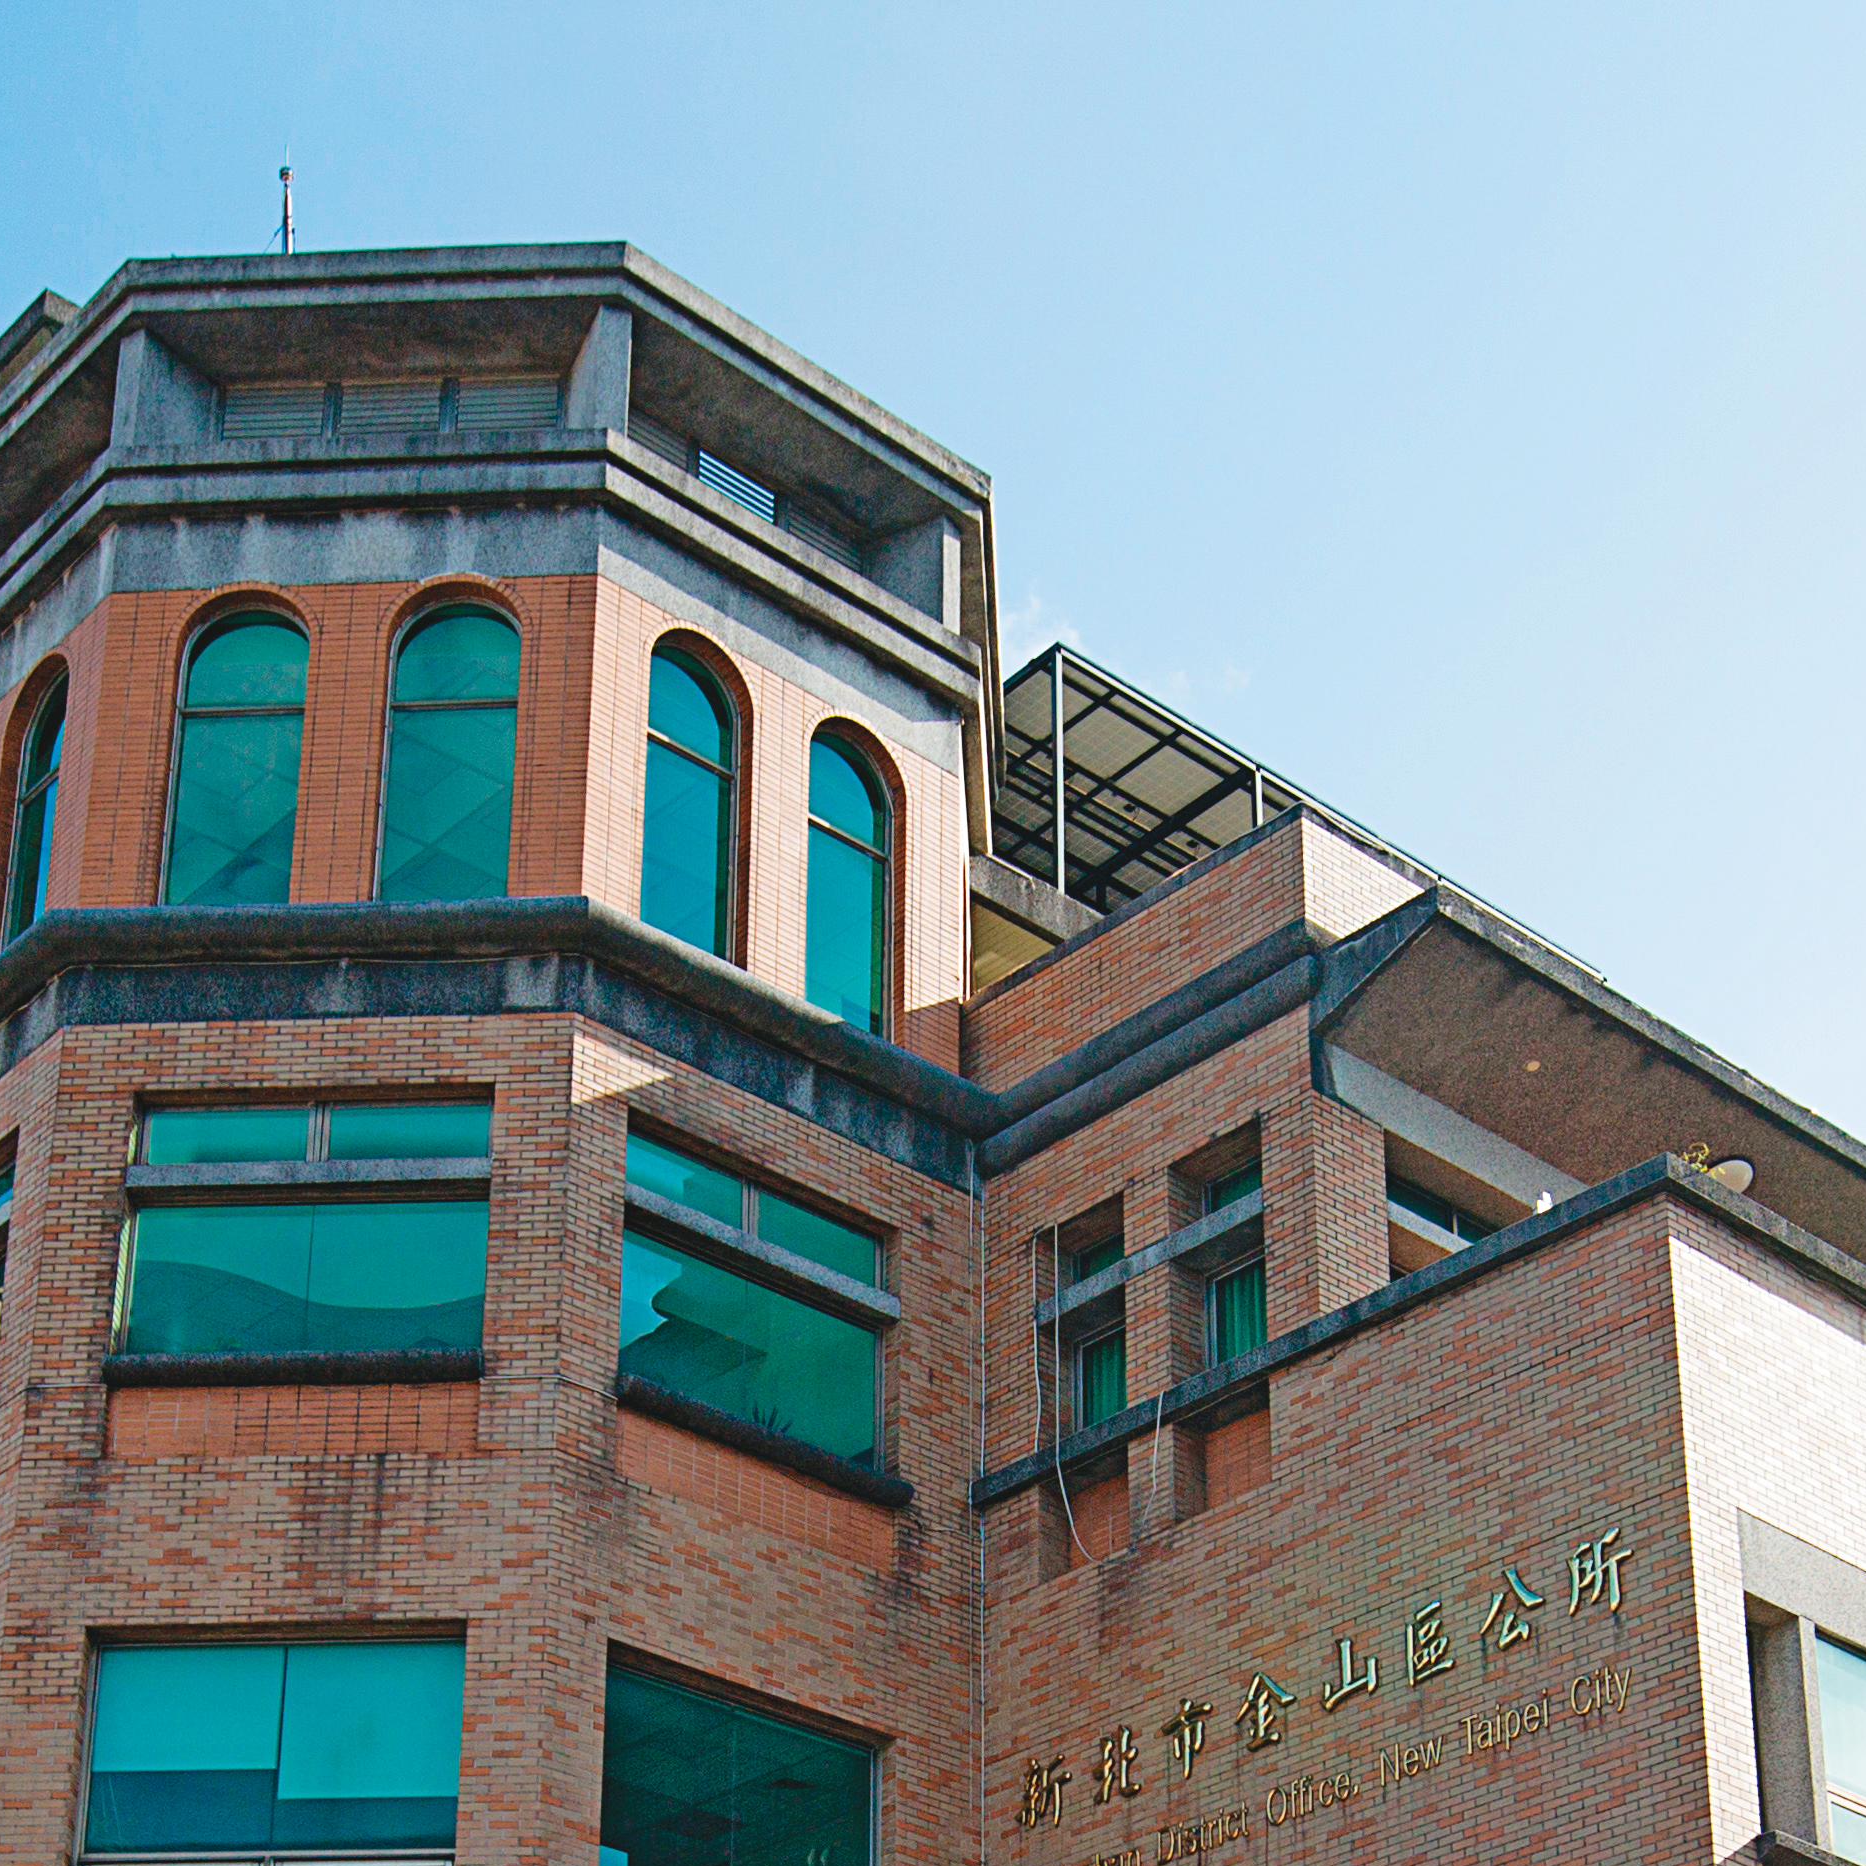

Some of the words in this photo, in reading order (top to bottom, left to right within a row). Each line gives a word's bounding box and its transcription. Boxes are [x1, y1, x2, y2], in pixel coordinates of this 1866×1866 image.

[1014, 1526, 1633, 1829] 新北市金山區公所
[1156, 1801, 1250, 1866] District
[1379, 1736, 1444, 1788] New
[1460, 1688, 1550, 1755] Taipei
[1569, 1665, 1632, 1716] City
